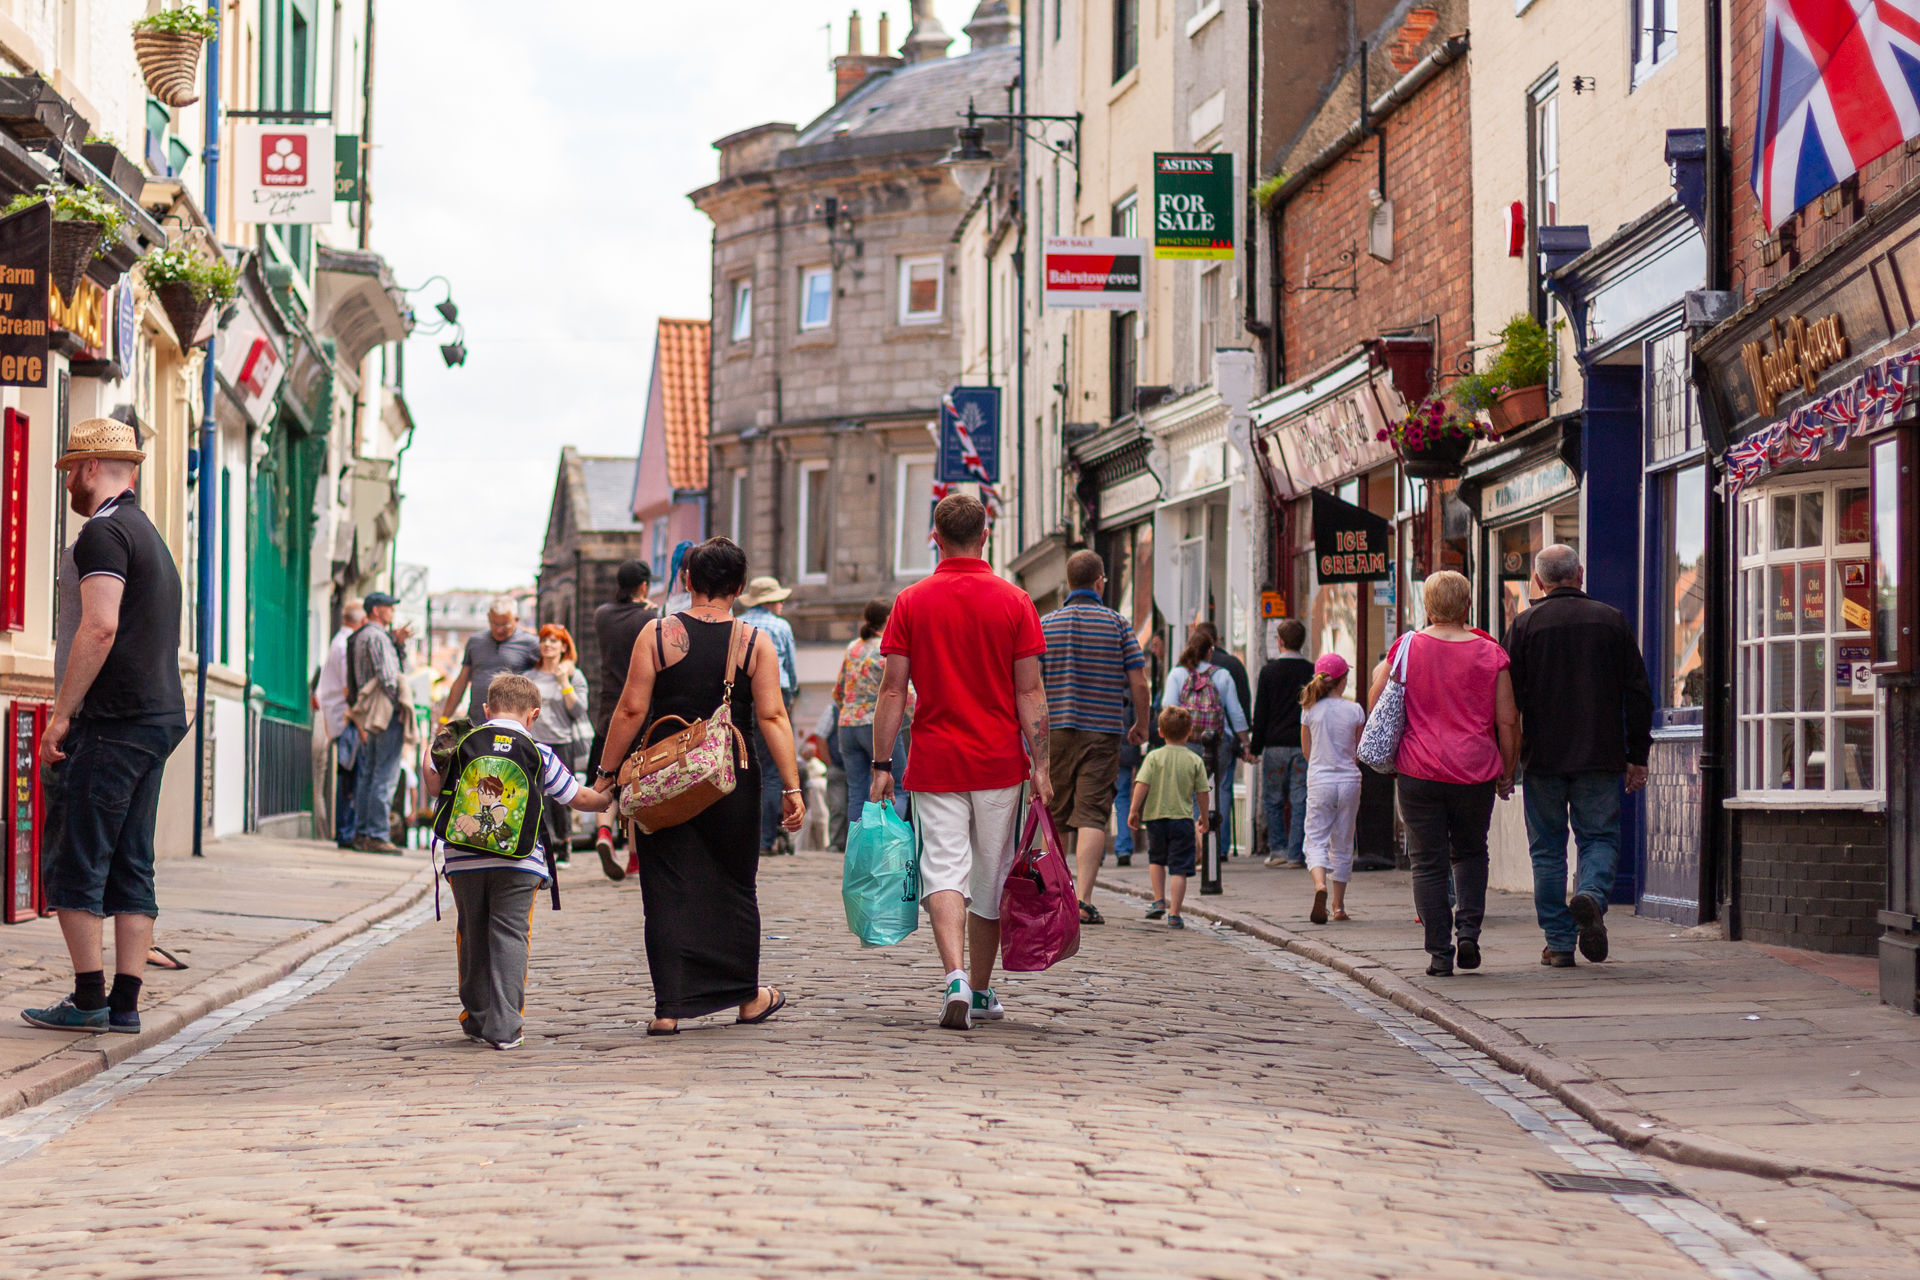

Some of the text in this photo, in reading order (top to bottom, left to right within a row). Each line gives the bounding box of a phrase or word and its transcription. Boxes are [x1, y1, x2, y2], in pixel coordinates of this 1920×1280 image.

[1162, 158, 1213, 171] ASTIN'S
[335, 178, 354, 193] OP
[1159, 194, 1206, 212] FOR
[1158, 212, 1215, 231] SALE
[1049, 239, 1093, 247] FOR SALE
[0, 264, 35, 285] Farm
[0, 293, 13, 312] ry
[0, 314, 46, 337] Cream
[1, 353, 42, 383] ere
[1336, 530, 1367, 552] ICE
[1321, 552, 1386, 576] CREAM
[1809, 579, 1819, 591] Old
[1779, 595, 1790, 607] Tea
[1805, 592, 1823, 605] World
[1776, 610, 1793, 621] Room
[1804, 607, 1823, 619] Charm
[494, 735, 512, 744] BEN
[493, 743, 512, 752] 10
